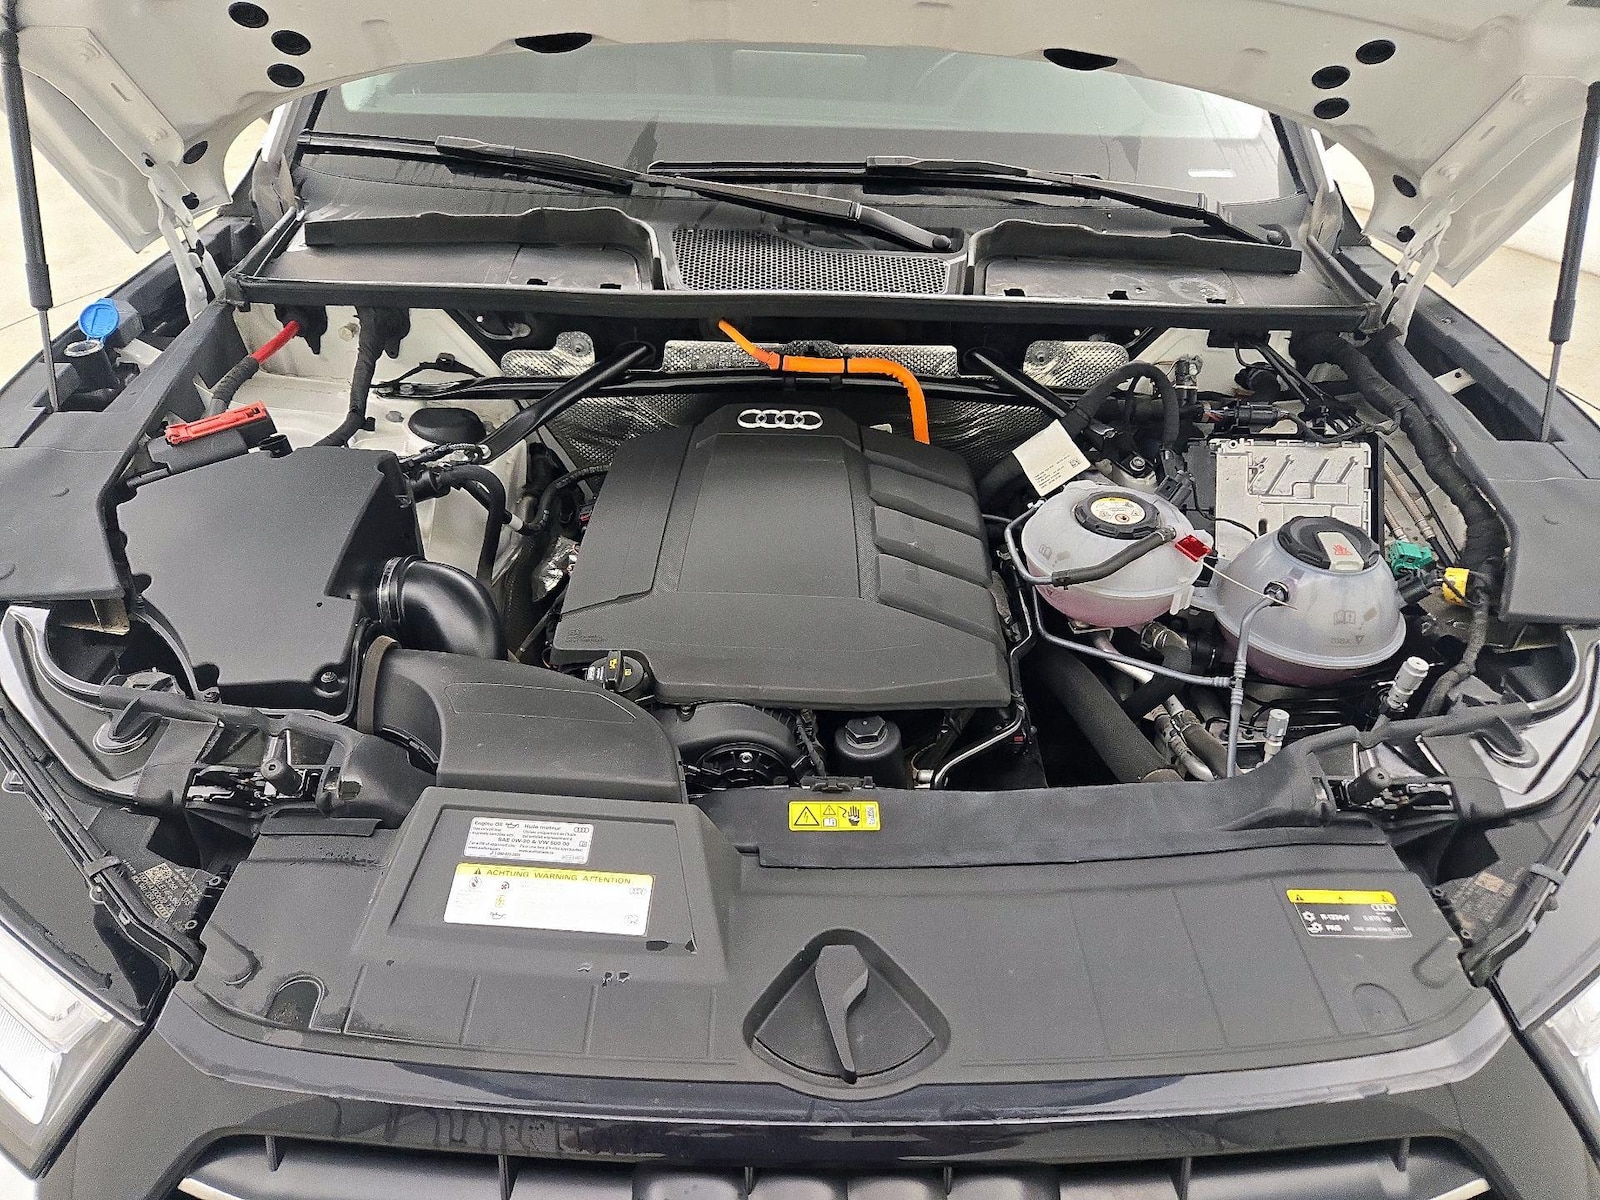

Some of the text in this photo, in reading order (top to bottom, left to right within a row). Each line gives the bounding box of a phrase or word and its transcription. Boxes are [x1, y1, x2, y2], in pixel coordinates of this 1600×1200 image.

[486, 869, 631, 885] ACHTUNG WARNING ATTENTION
